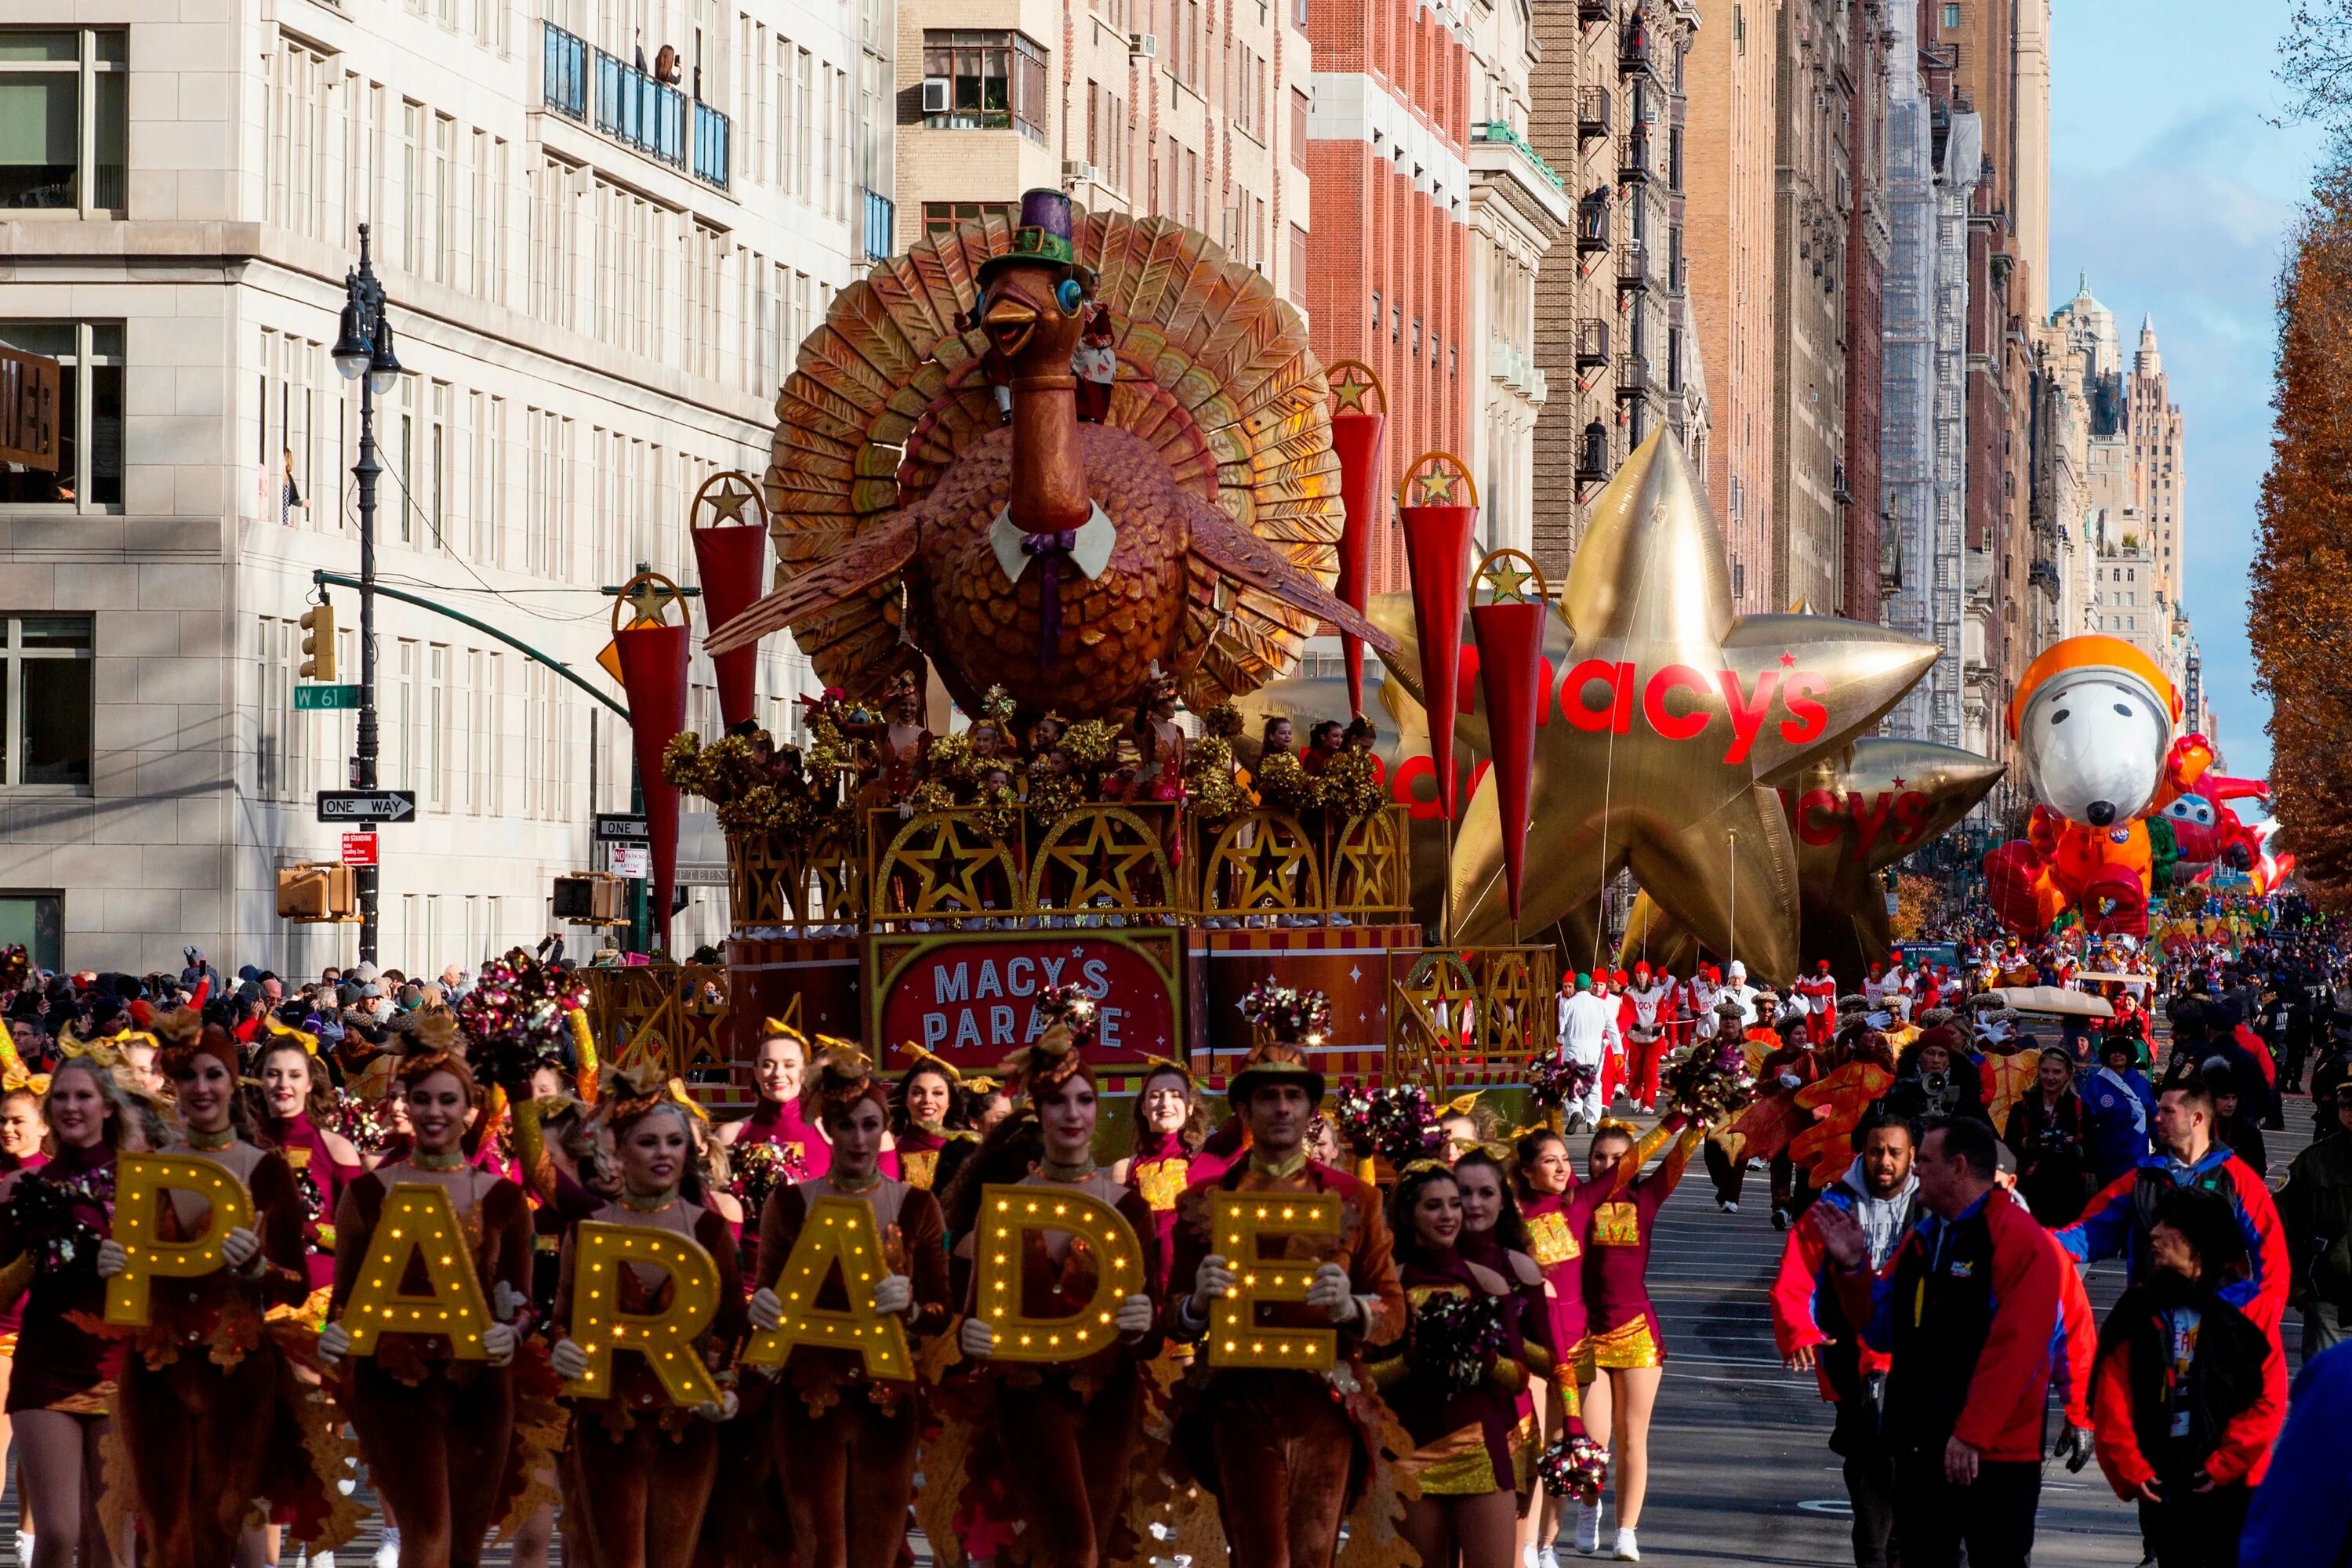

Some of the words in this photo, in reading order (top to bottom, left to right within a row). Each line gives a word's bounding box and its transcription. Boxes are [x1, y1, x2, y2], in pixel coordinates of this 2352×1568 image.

[297, 689, 312, 706] W
[321, 689, 338, 706] 61
[326, 800, 355, 813] ONE
[371, 800, 402, 813] WAY
[608, 822, 631, 833] ONE
[615, 851, 624, 861] NO
[679, 870, 725, 879] FTEEN
[923, 1005, 1122, 1052] PARAE
